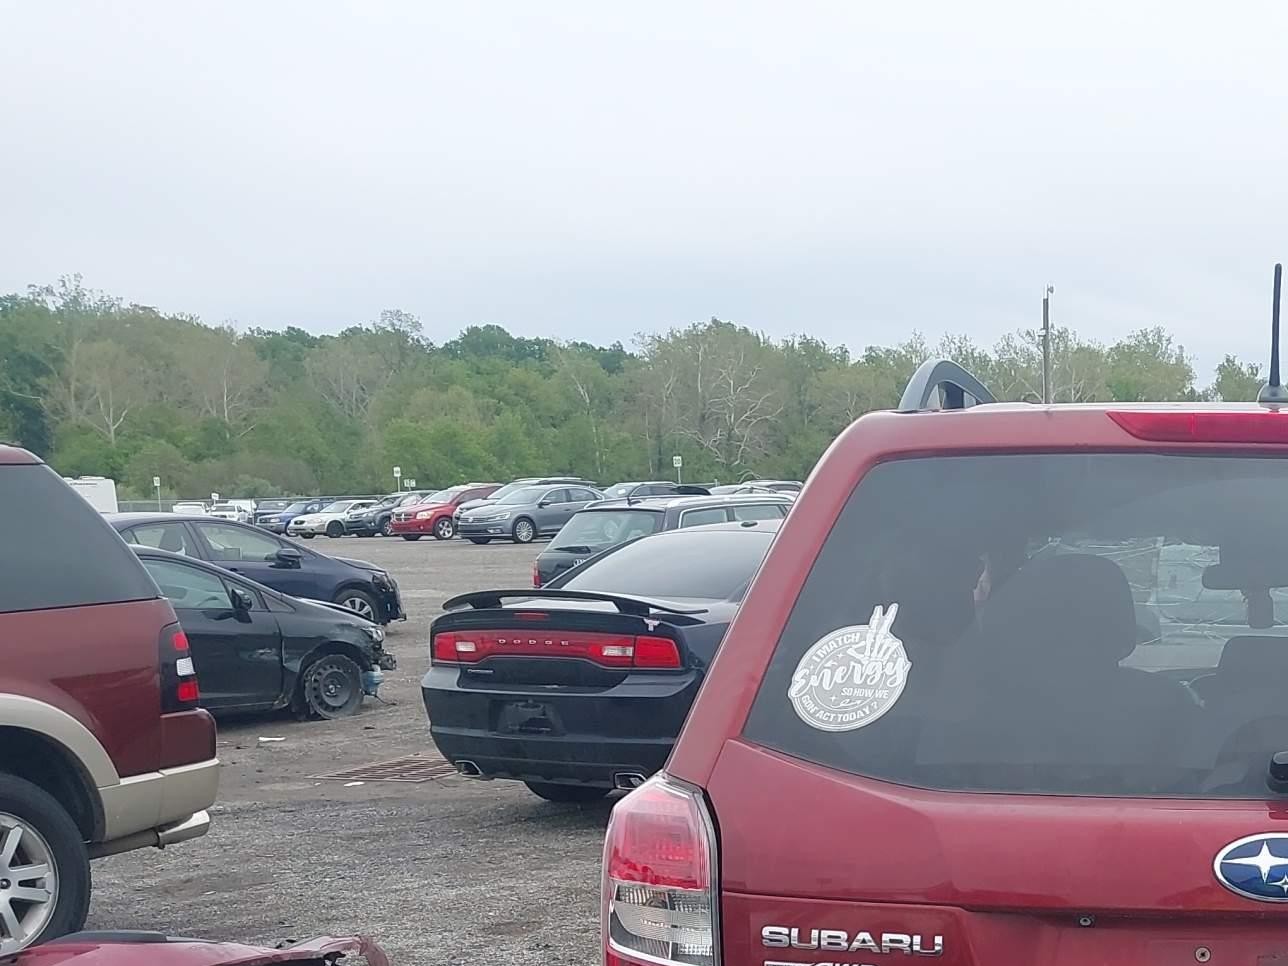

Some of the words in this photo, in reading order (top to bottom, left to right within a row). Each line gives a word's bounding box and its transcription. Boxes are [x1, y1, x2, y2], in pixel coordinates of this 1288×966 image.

[498, 638, 569, 646] DODGE
[816, 632, 861, 658] MATCH
[790, 657, 907, 698] Energy
[840, 687, 853, 696] SO
[854, 687, 874, 698] HOW
[875, 689, 890, 699] WE
[815, 710, 837, 722] ACT
[837, 704, 871, 722] TODAY
[760, 925, 944, 957] SUBARU
